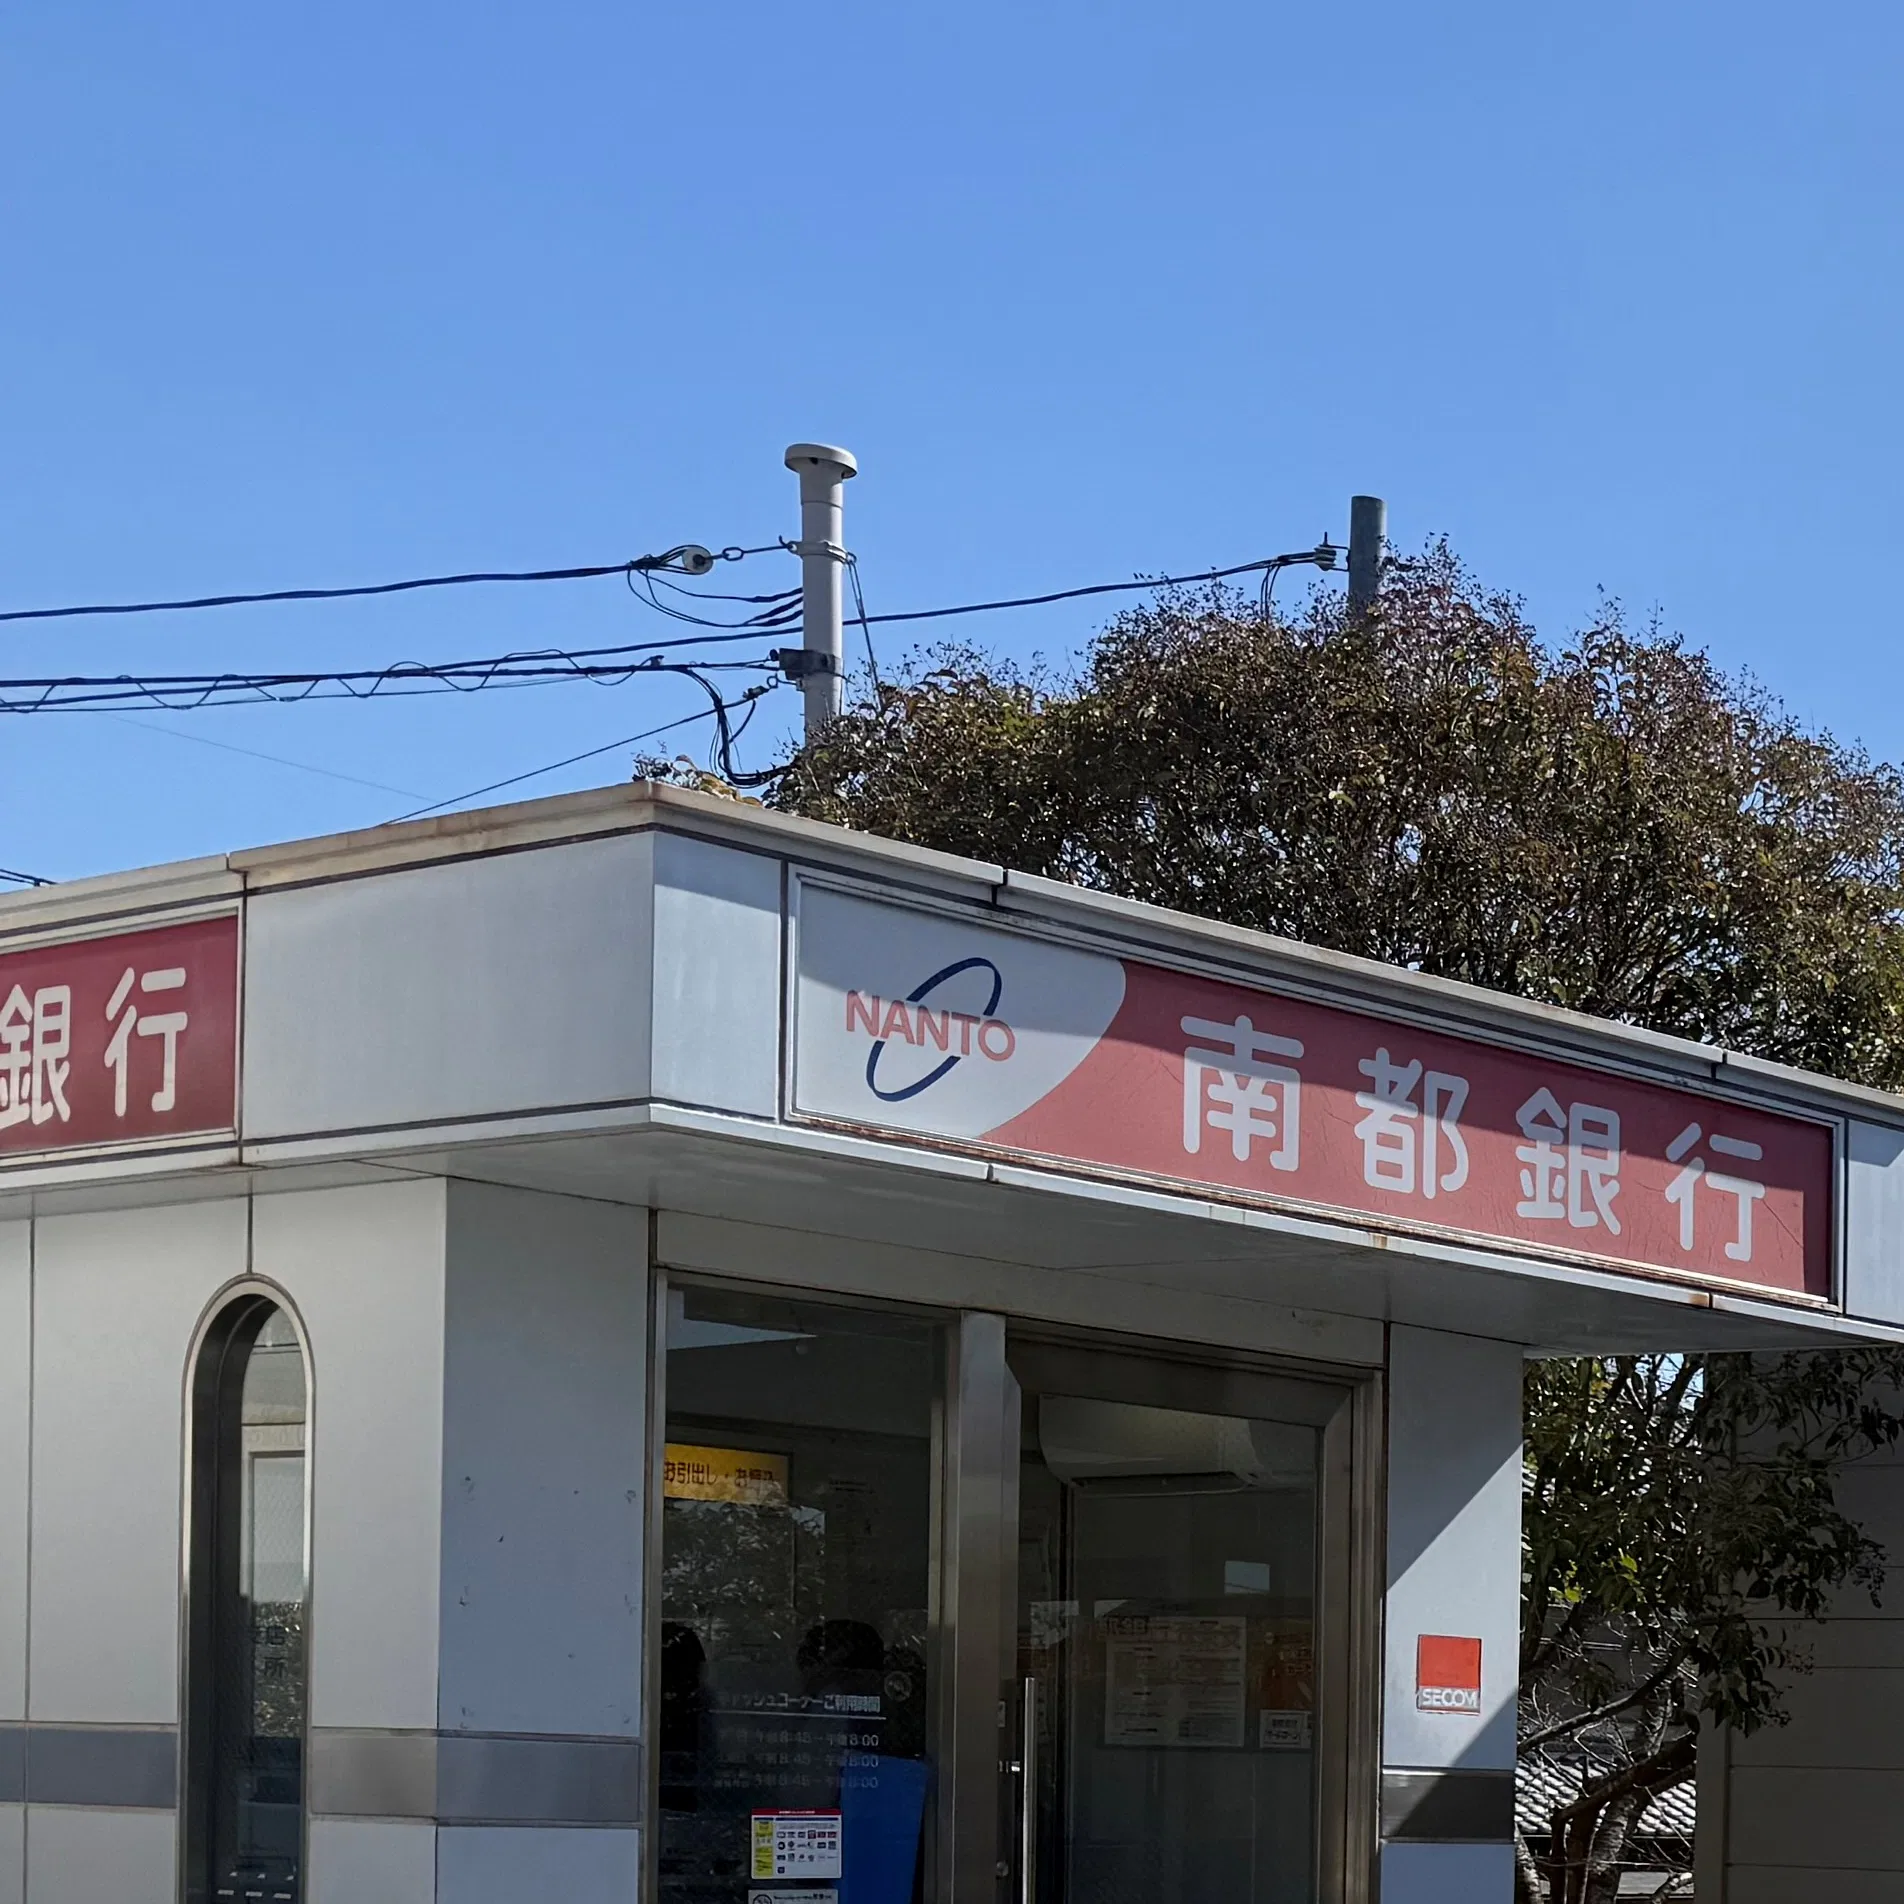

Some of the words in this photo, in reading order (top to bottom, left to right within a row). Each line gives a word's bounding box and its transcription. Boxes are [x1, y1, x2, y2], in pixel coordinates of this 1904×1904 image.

[0, 966, 189, 1128] 銀行
[845, 988, 1016, 1063] NANTO
[1178, 1014, 1766, 1262] 南都銀行
[1420, 1688, 1479, 1708] SECOM
